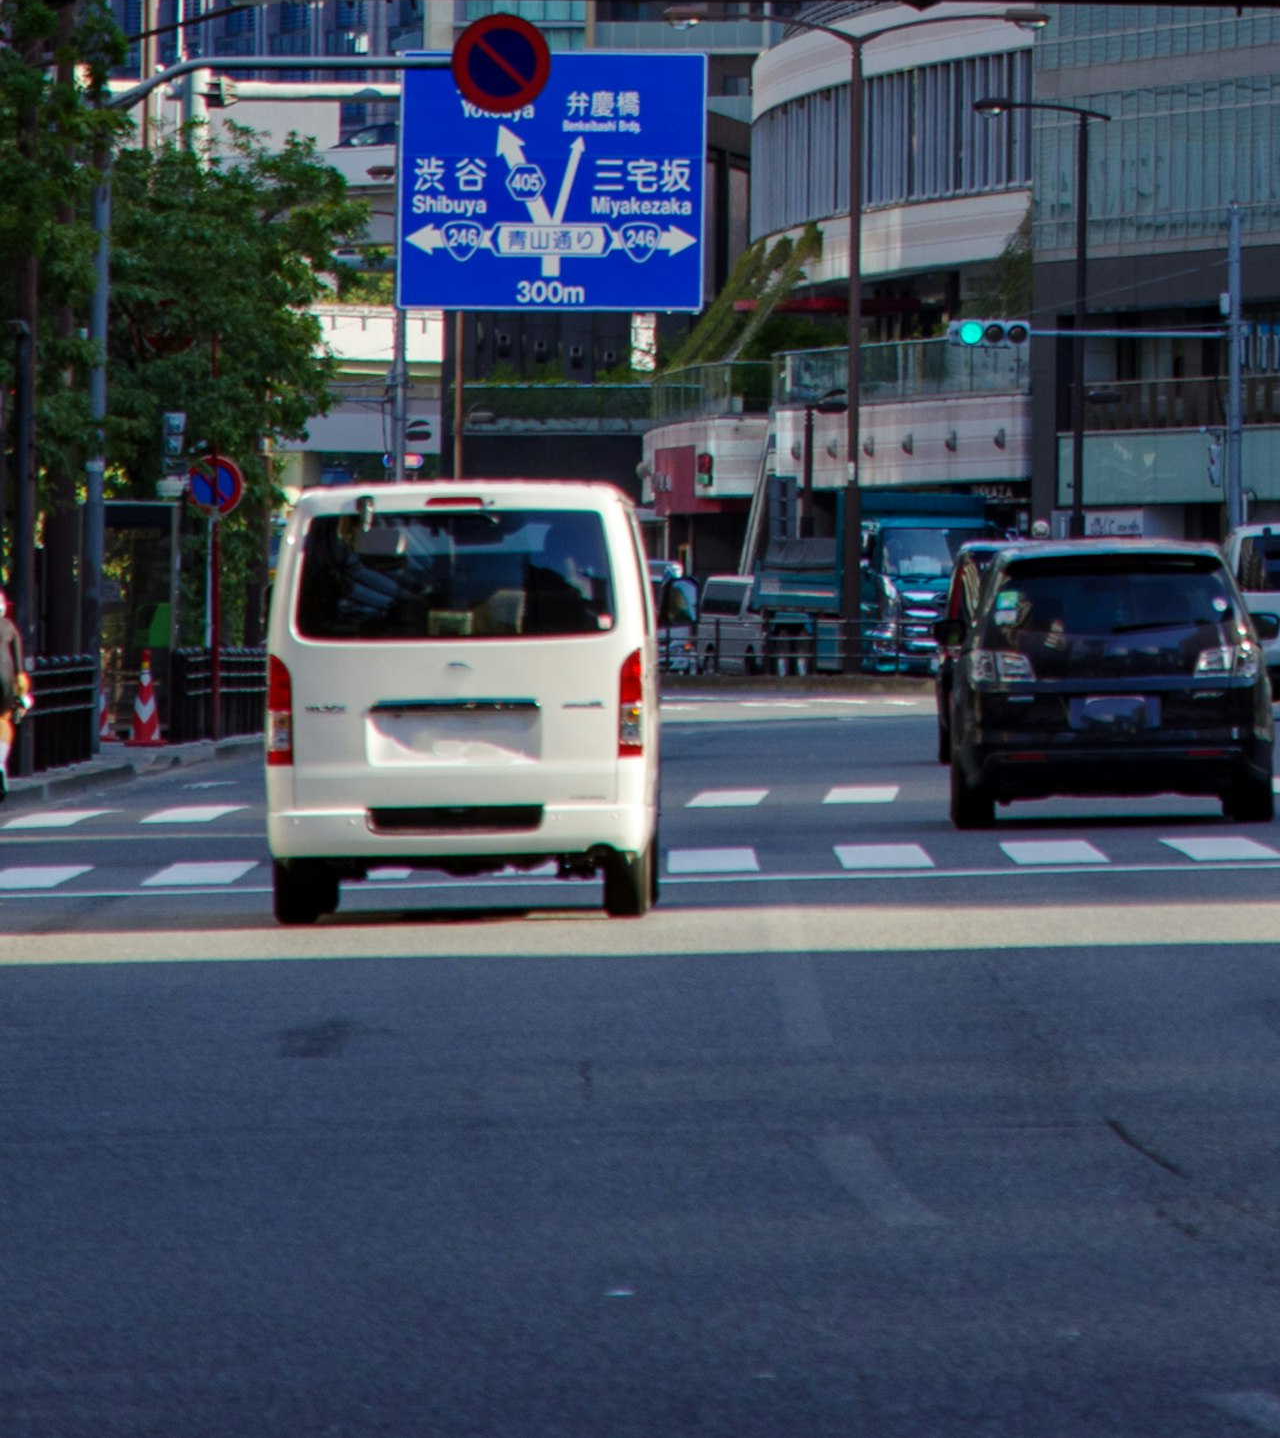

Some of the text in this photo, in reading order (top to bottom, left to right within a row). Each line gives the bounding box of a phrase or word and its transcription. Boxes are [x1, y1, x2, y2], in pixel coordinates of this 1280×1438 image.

[566, 91, 640, 117] 弁慶橋
[563, 120, 616, 132] Benkeibashi
[414, 157, 487, 192] 渋谷
[511, 174, 541, 192] 405
[593, 158, 692, 193] 三宅坂
[412, 195, 487, 217] Shibuya
[591, 196, 692, 218] Miyakezaka
[449, 229, 478, 247] 246
[507, 230, 594, 251] 青山通り
[625, 230, 655, 248] 246
[516, 280, 585, 304] 300m
